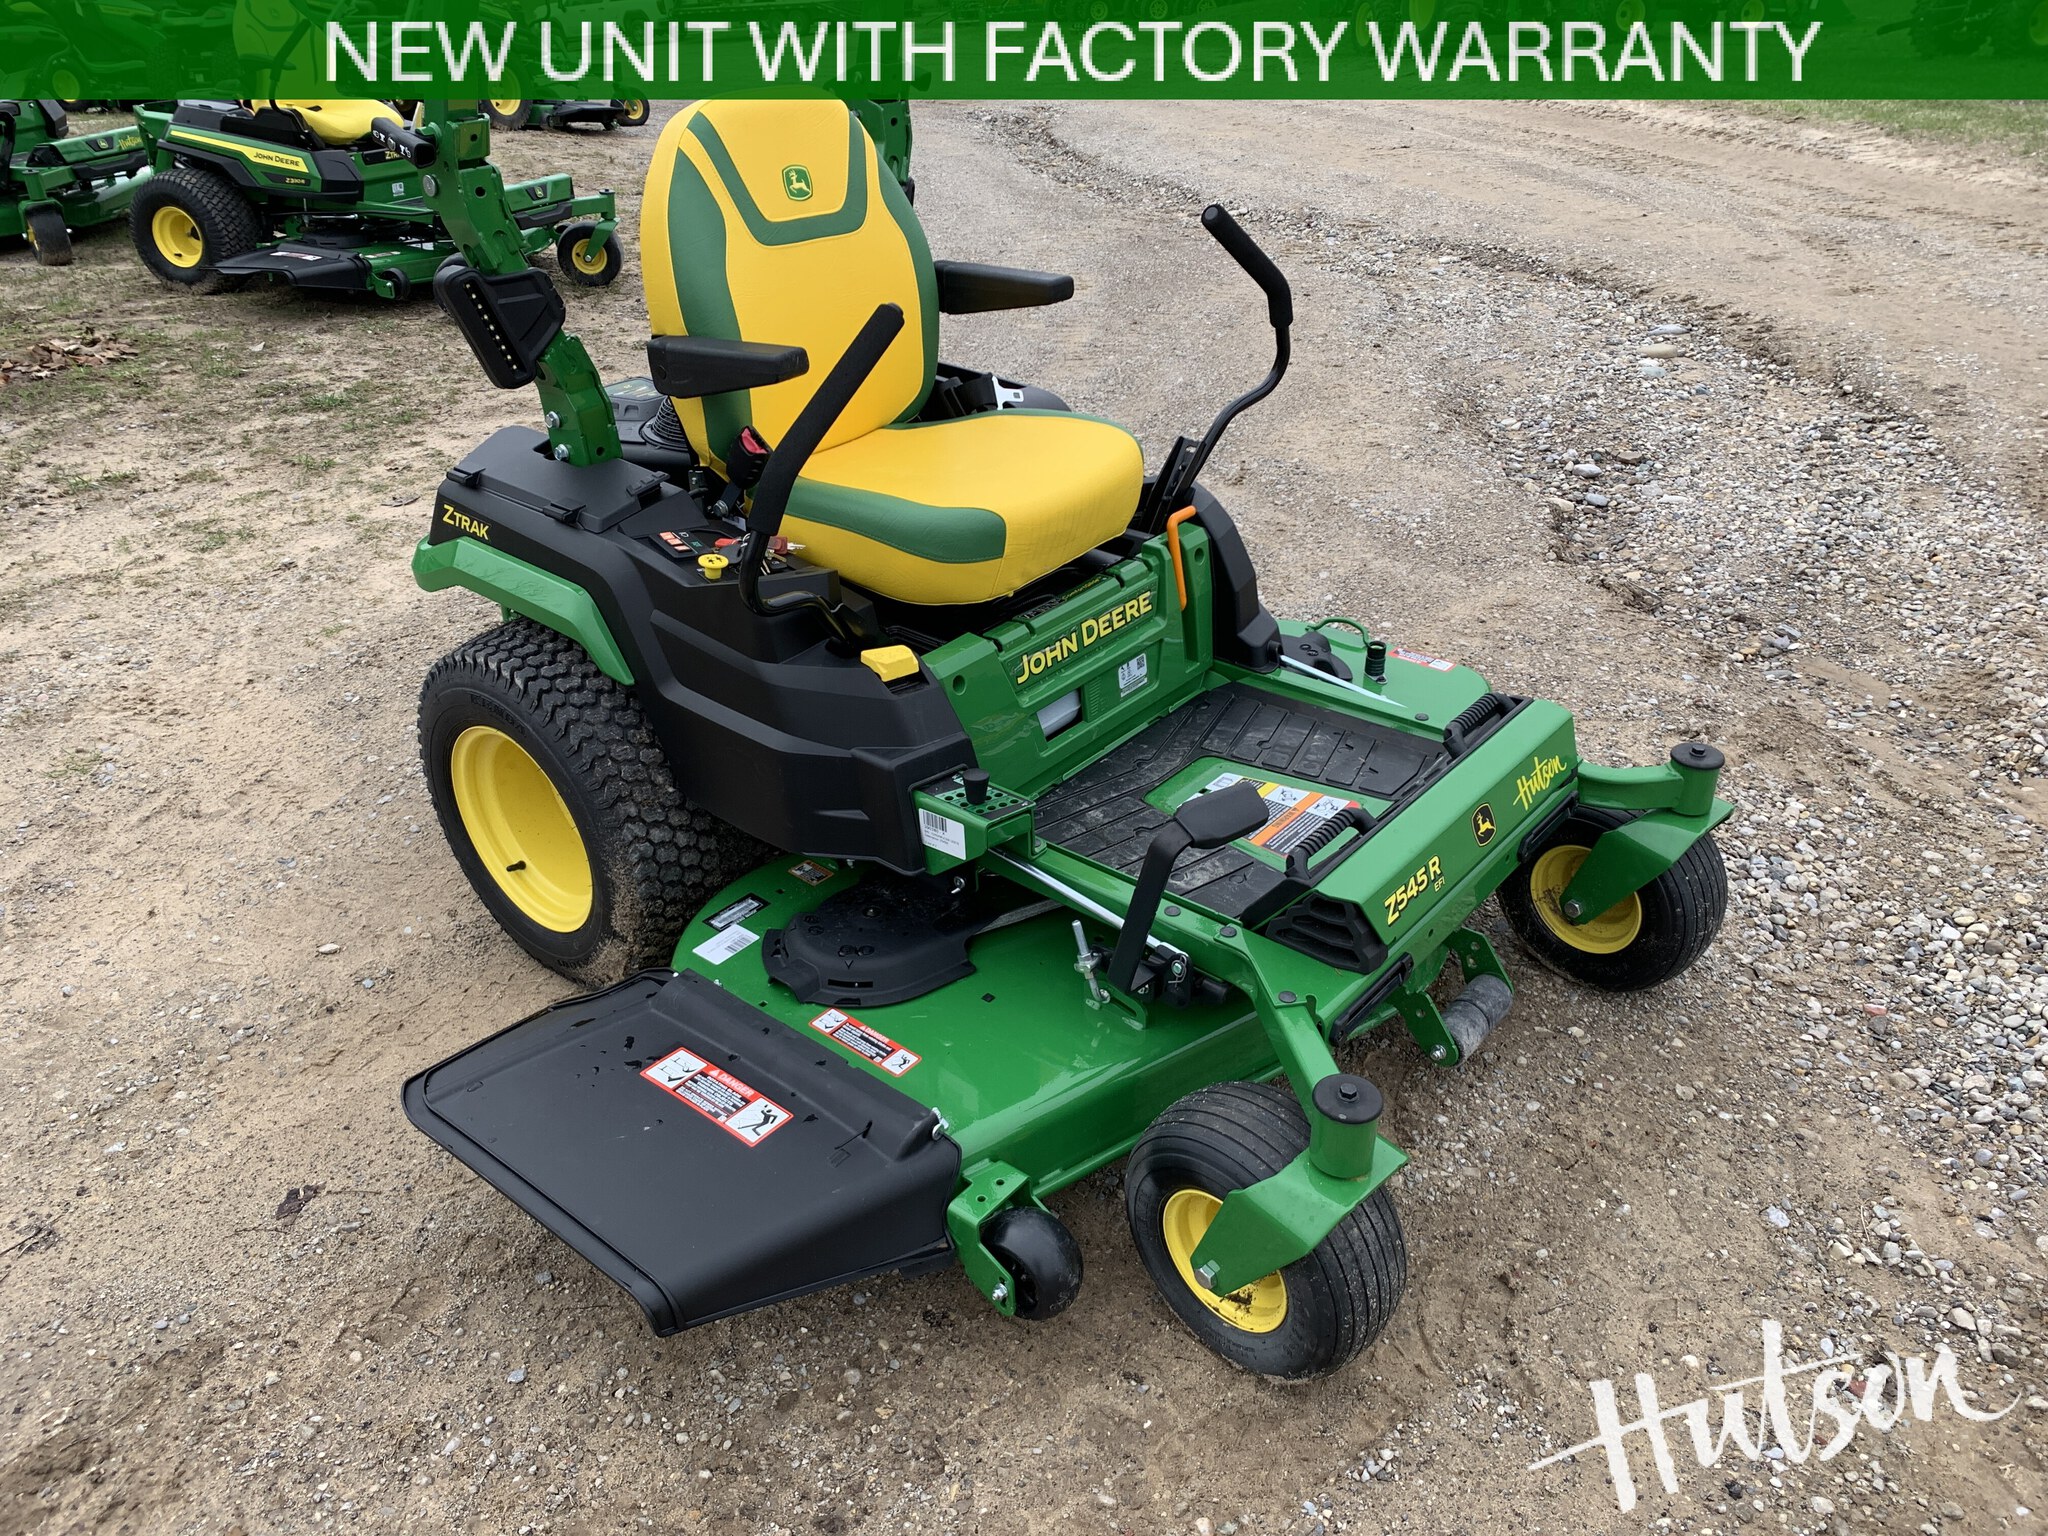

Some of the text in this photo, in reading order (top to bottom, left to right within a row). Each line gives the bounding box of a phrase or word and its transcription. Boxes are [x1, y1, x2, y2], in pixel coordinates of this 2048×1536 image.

[253, 152, 300, 167] JOHN DEERE
[442, 503, 490, 541] ZTRAK
[1017, 631, 1078, 685] JOHN
[1081, 590, 1153, 648] DEERE
[1512, 754, 1568, 812] Hutson
[1434, 875, 1446, 892] EFI
[717, 1073, 756, 1098] DANGER
